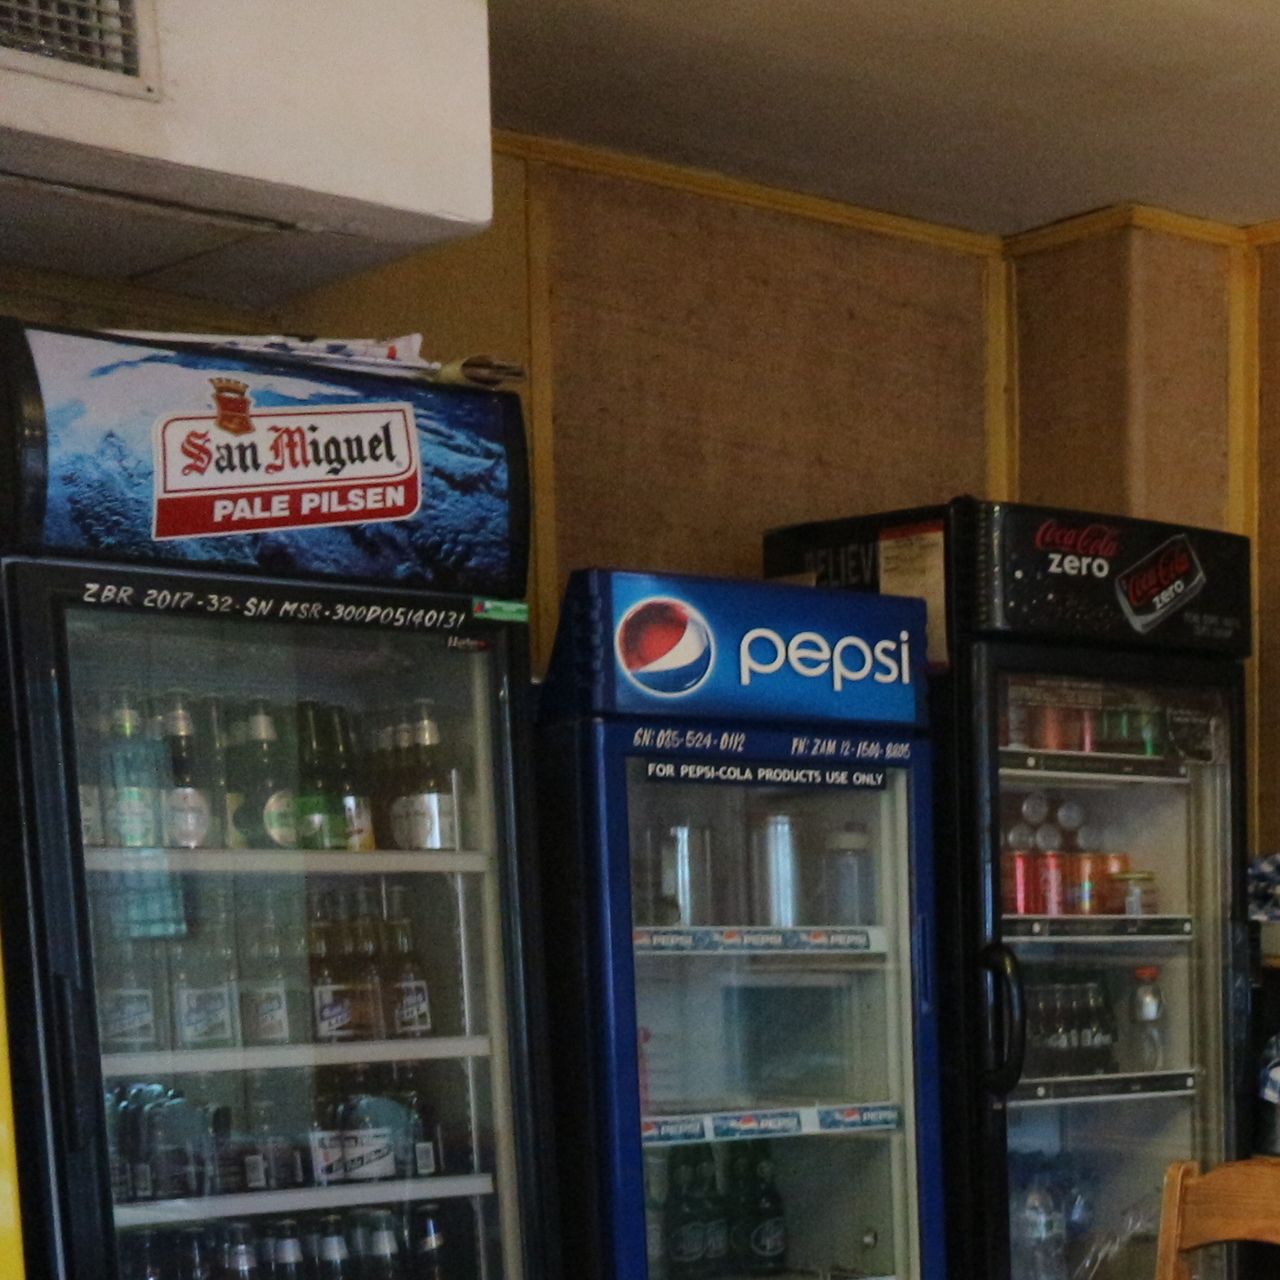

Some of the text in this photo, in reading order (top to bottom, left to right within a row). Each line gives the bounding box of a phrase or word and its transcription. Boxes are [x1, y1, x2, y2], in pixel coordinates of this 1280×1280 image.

[181, 420, 397, 476] San Miguel
[213, 485, 405, 523] PALE PILSEN
[1047, 553, 1110, 578] zero
[83, 583, 134, 606] ZBR
[1152, 579, 1185, 609] zero
[739, 628, 910, 691] pepsi
[648, 763, 884, 786] FOR PEPSI-COLA PRODUCTS USE ONLY
